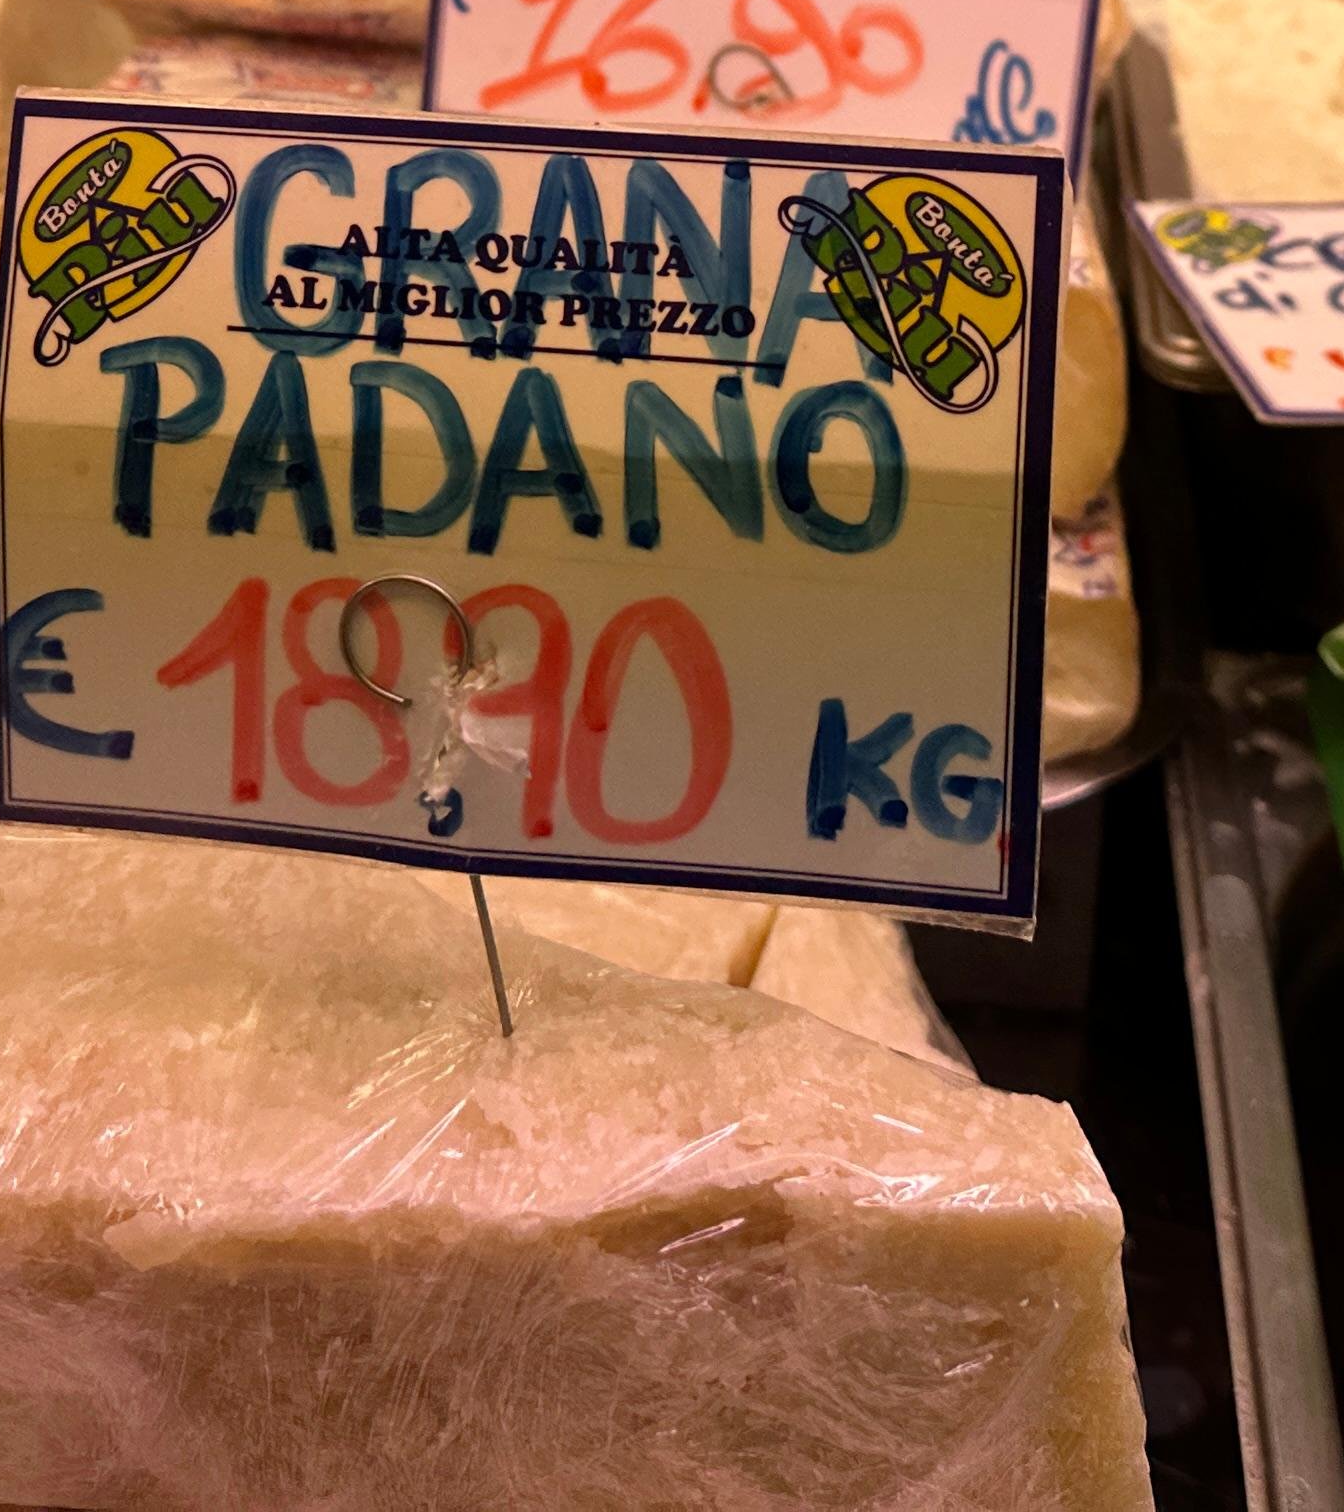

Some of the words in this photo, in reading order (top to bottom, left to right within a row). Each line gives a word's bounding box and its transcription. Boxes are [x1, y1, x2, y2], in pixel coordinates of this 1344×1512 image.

[234, 142, 896, 390] GRANA
[261, 274, 329, 311] AL
[336, 276, 549, 326] MIGLIOR
[557, 292, 757, 340] PREZZO
[337, 223, 465, 265] ALTA
[473, 231, 696, 279] QUALITÀ
[99, 334, 910, 554] PADANO
[2, 586, 134, 760] €
[803, 695, 1003, 844] KG
